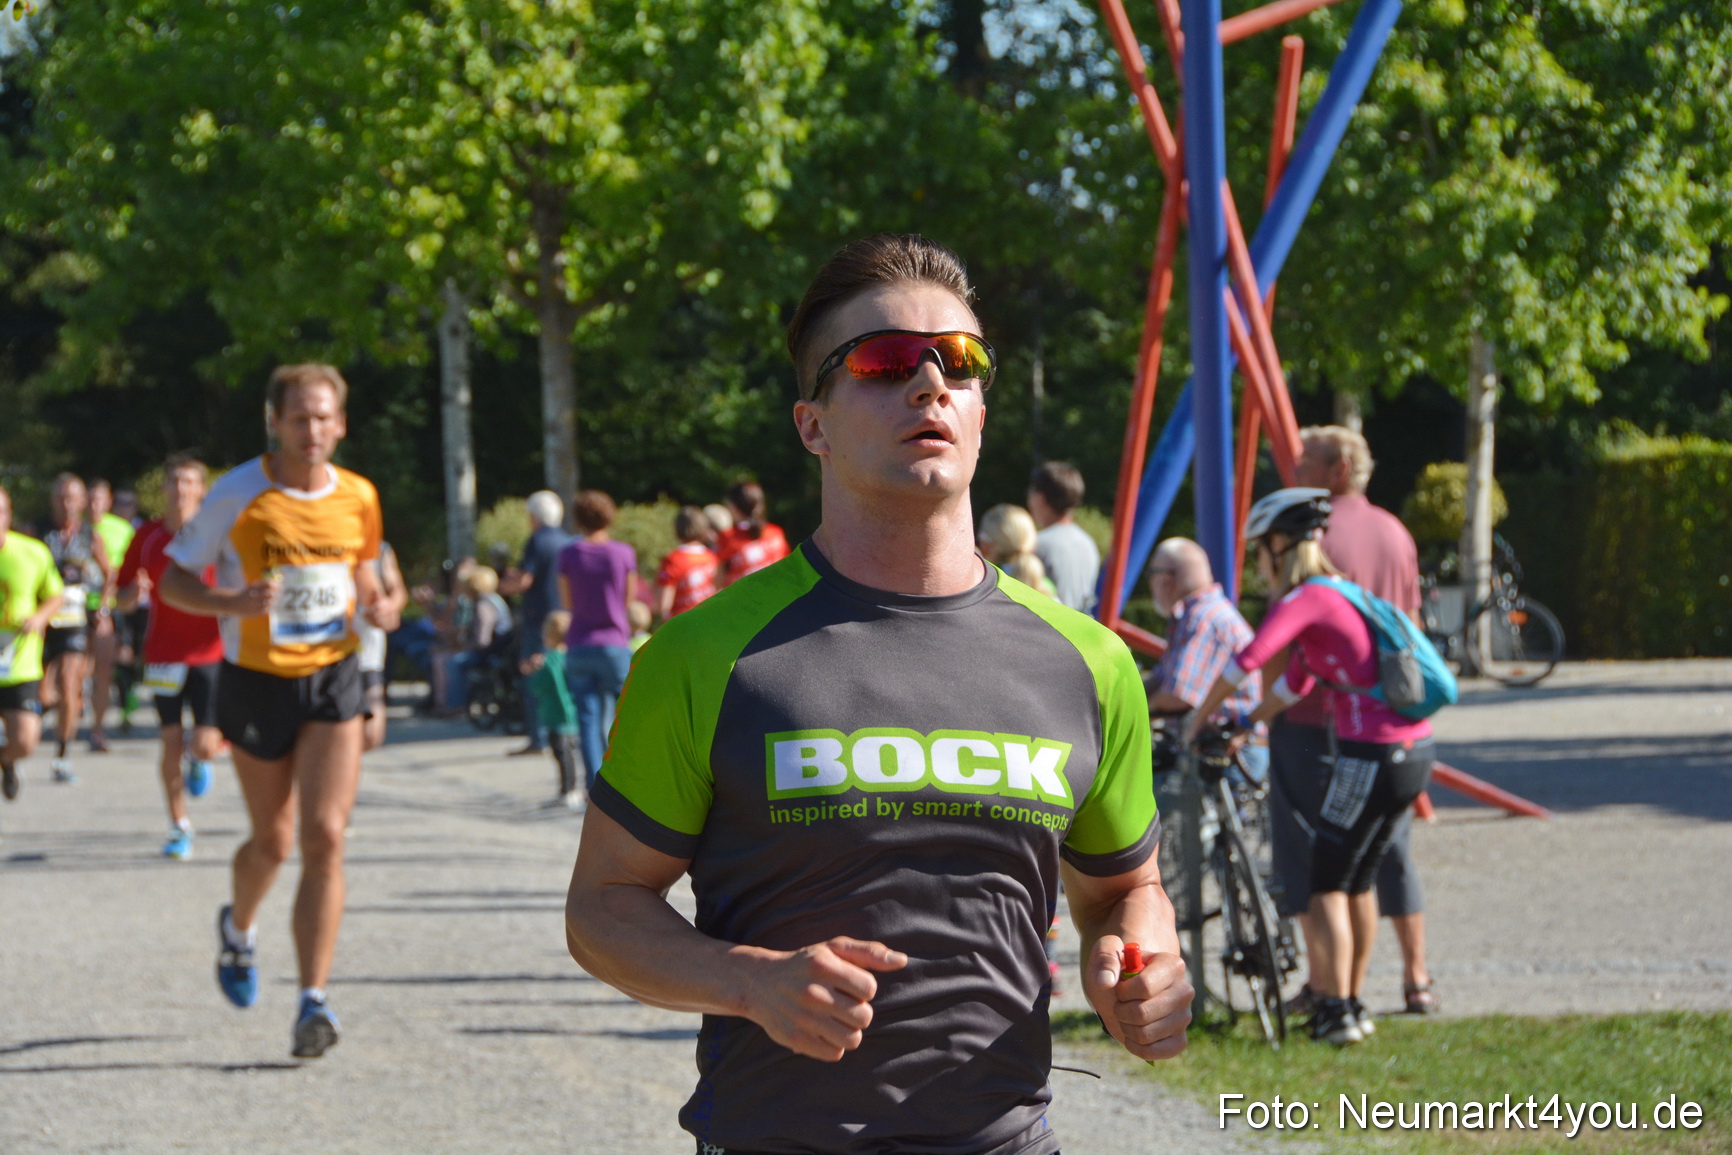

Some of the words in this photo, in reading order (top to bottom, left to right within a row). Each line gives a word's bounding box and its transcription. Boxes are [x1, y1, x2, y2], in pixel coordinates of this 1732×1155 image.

[770, 732, 1071, 803] BOCK
[769, 798, 868, 826] inspired
[876, 797, 905, 821] by
[911, 800, 983, 818] smart
[989, 803, 1069, 833] concepts
